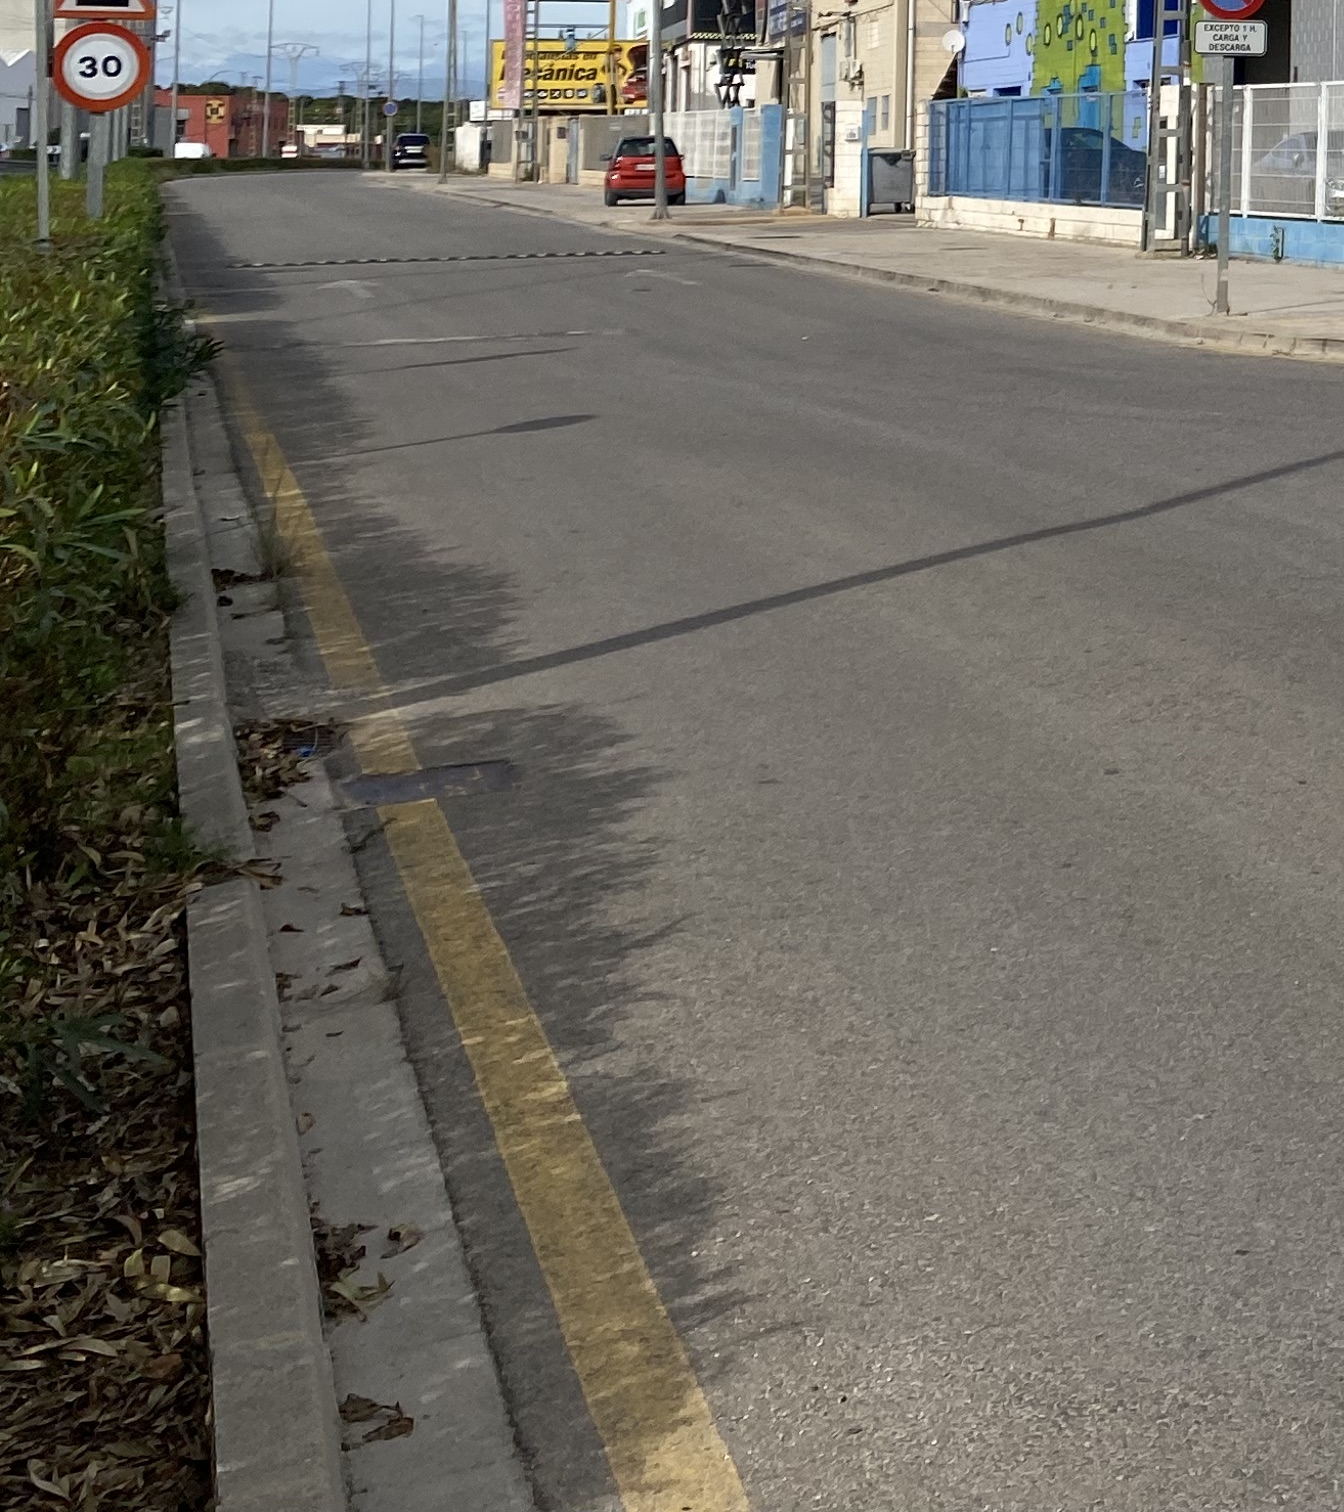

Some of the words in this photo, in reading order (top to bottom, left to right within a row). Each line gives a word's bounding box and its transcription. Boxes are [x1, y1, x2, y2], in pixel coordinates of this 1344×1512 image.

[1204, 24, 1240, 33] EXCEPTO
[1213, 33, 1239, 42] CARGA
[1242, 34, 1248, 42] Y
[1208, 43, 1251, 52] DESCARGA
[78, 55, 122, 79] 30
[499, 63, 598, 82] ecánica
